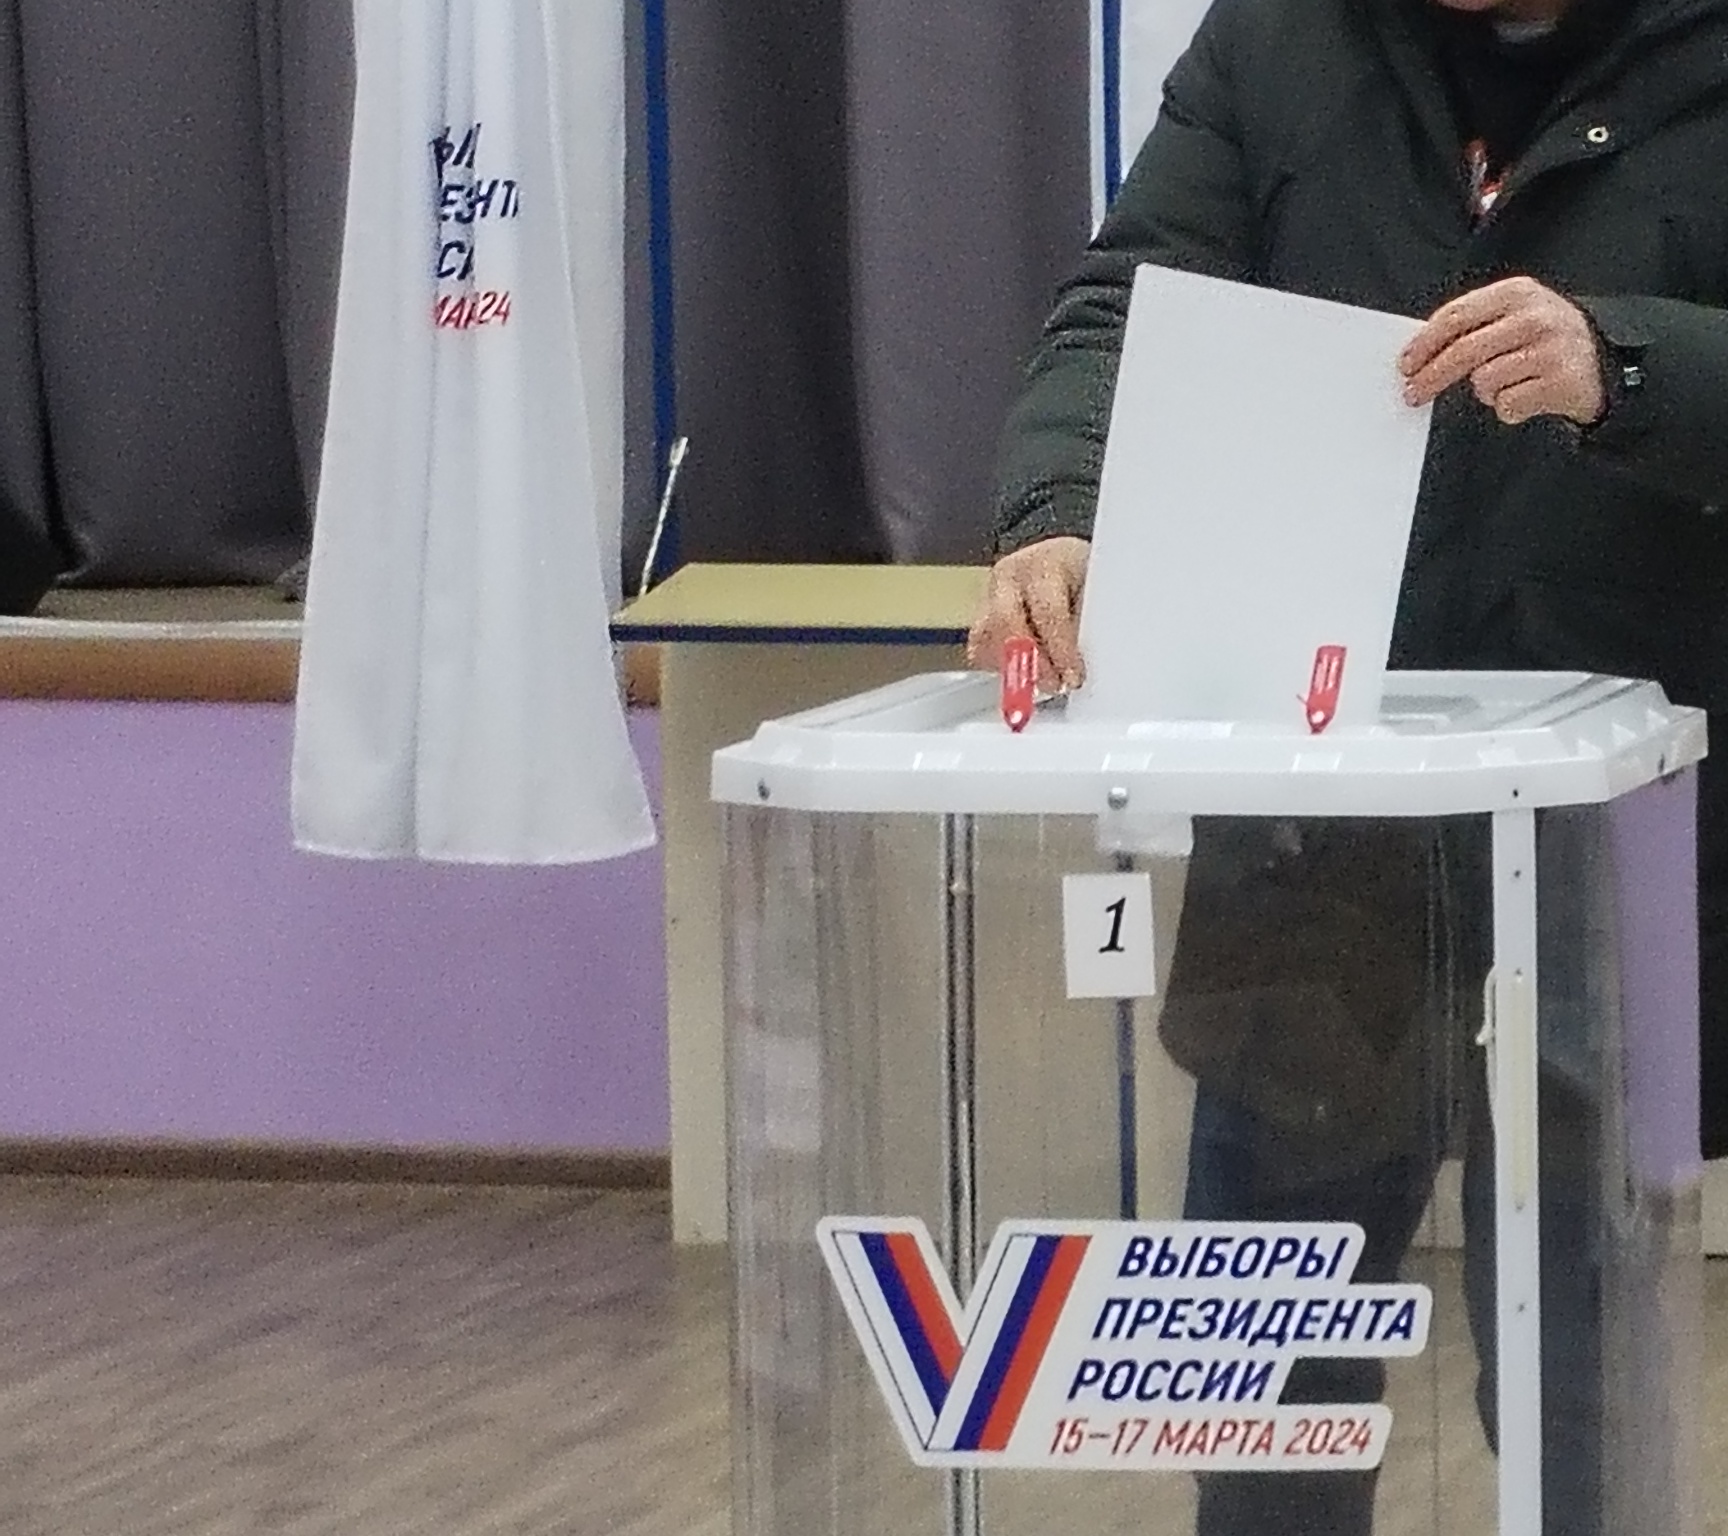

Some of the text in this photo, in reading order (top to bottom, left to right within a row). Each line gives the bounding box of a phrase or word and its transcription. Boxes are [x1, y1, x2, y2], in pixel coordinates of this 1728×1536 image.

[1099, 897, 1126, 953] 1
[1117, 1236, 1350, 1280] ВЫБОРЫ
[1092, 1297, 1418, 1347] ПРЕЗИДЕНТА
[1067, 1358, 1276, 1403] РОССИИ
[1152, 1418, 1276, 1456] МАРТА
[1283, 1416, 1373, 1456] 2024
